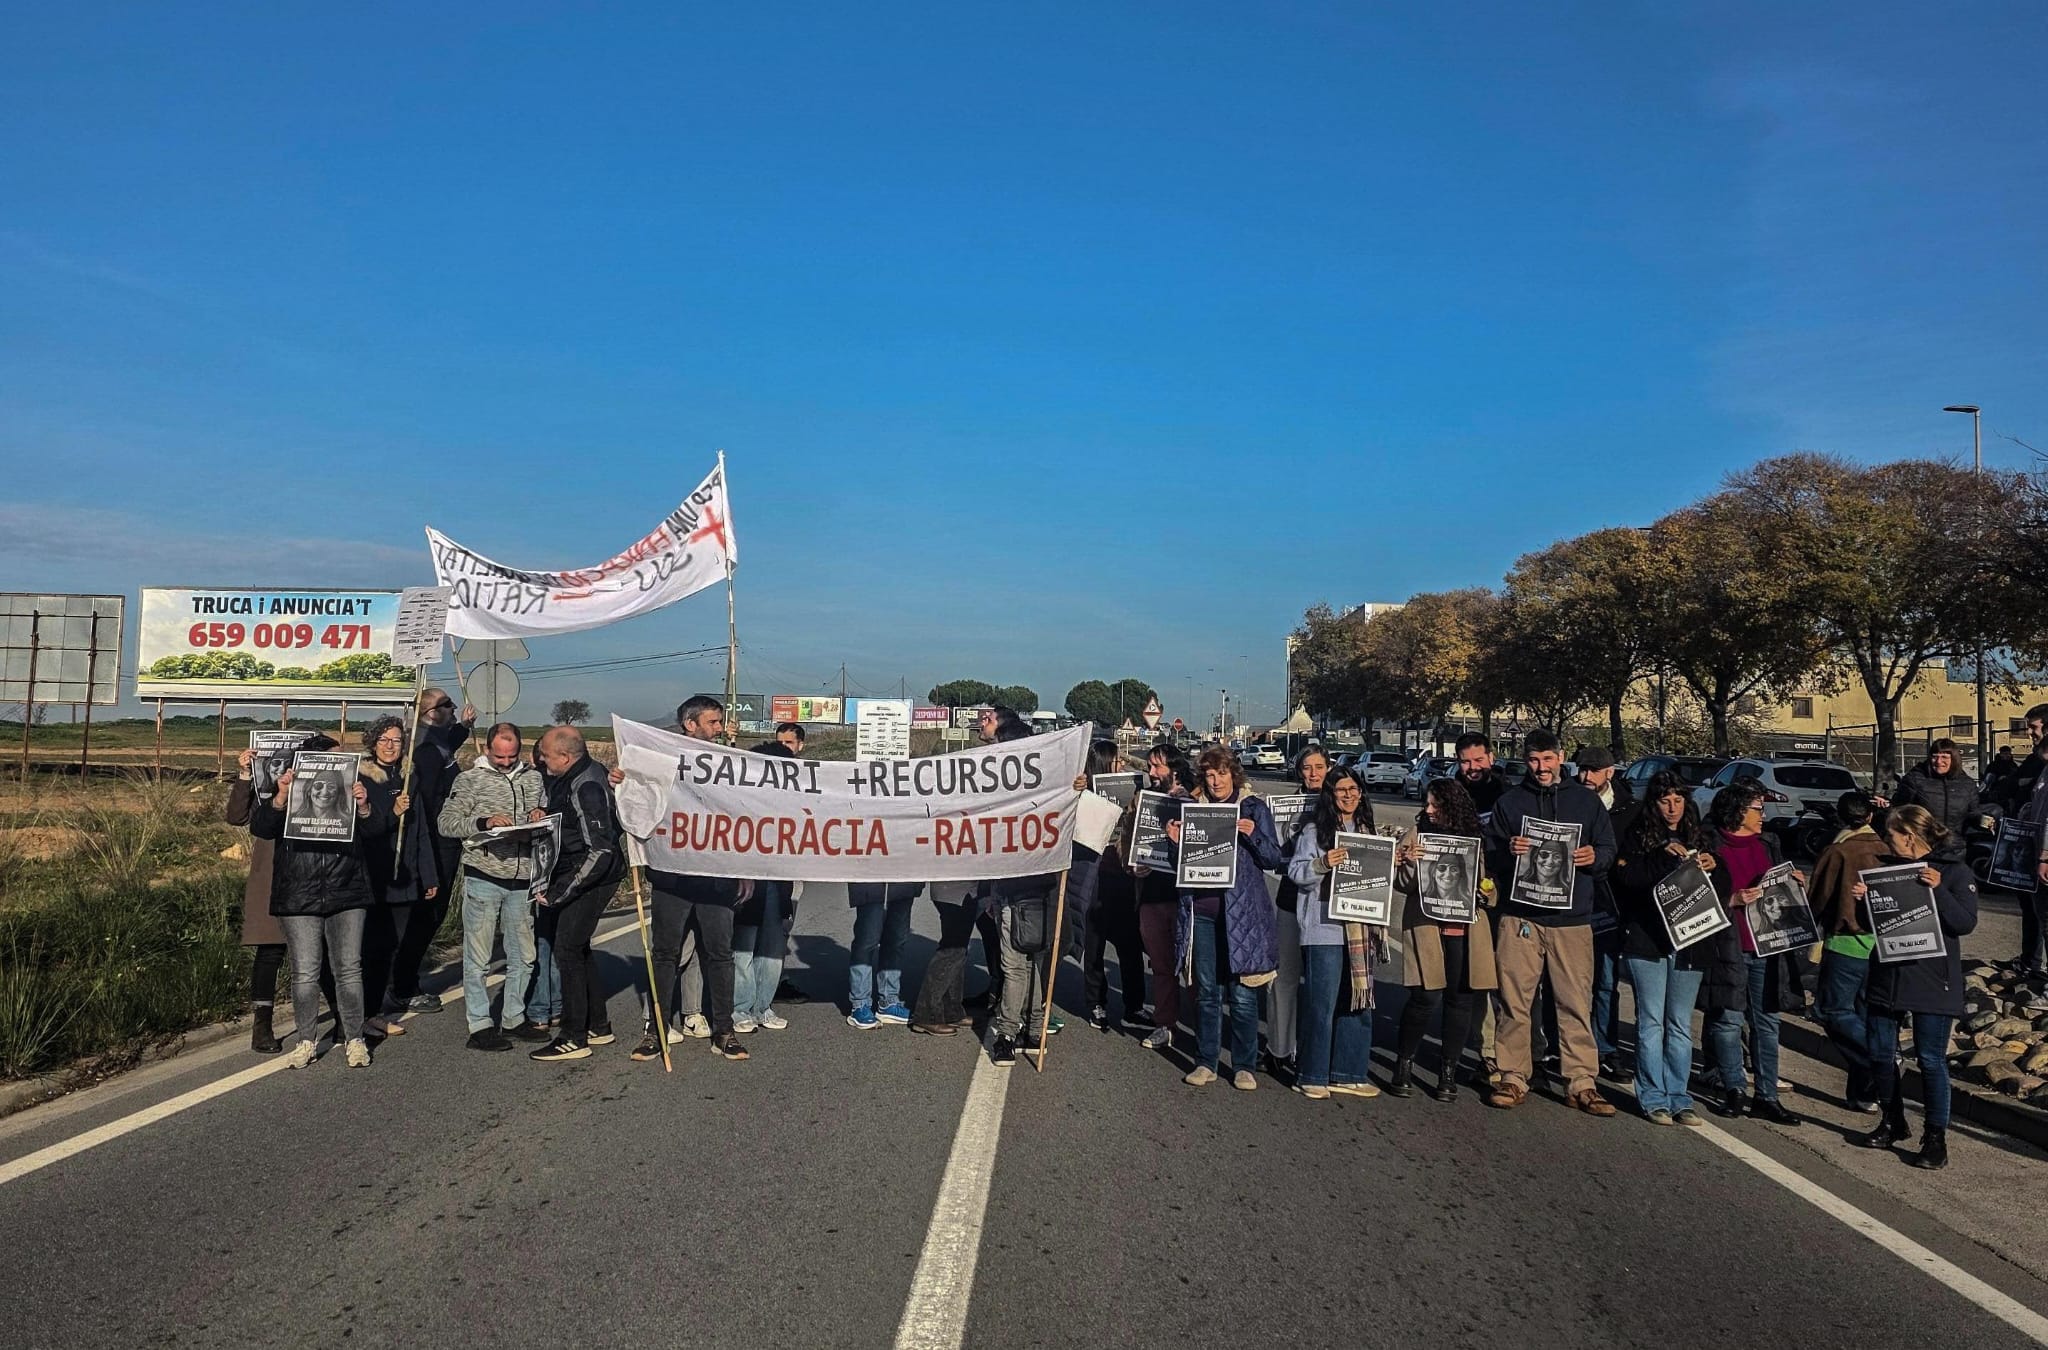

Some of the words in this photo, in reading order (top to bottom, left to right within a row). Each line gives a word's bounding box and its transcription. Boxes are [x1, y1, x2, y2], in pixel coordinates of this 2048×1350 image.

[192, 597, 253, 614] TRUCA
[258, 597, 265, 615] i
[270, 597, 372, 616] ANUNCIA'T
[188, 622, 246, 648] 659
[253, 623, 313, 649] 009
[321, 624, 371, 650] 471
[677, 753, 822, 794] +SALARI
[847, 752, 1042, 797] +RECURSOS
[656, 808, 889, 856] -BUROCRÀCIA
[915, 811, 1060, 856] -RÀTIOS
[1186, 822, 1196, 830] JA
[1338, 863, 1362, 873] PROU
[1873, 901, 1899, 910] PROU
